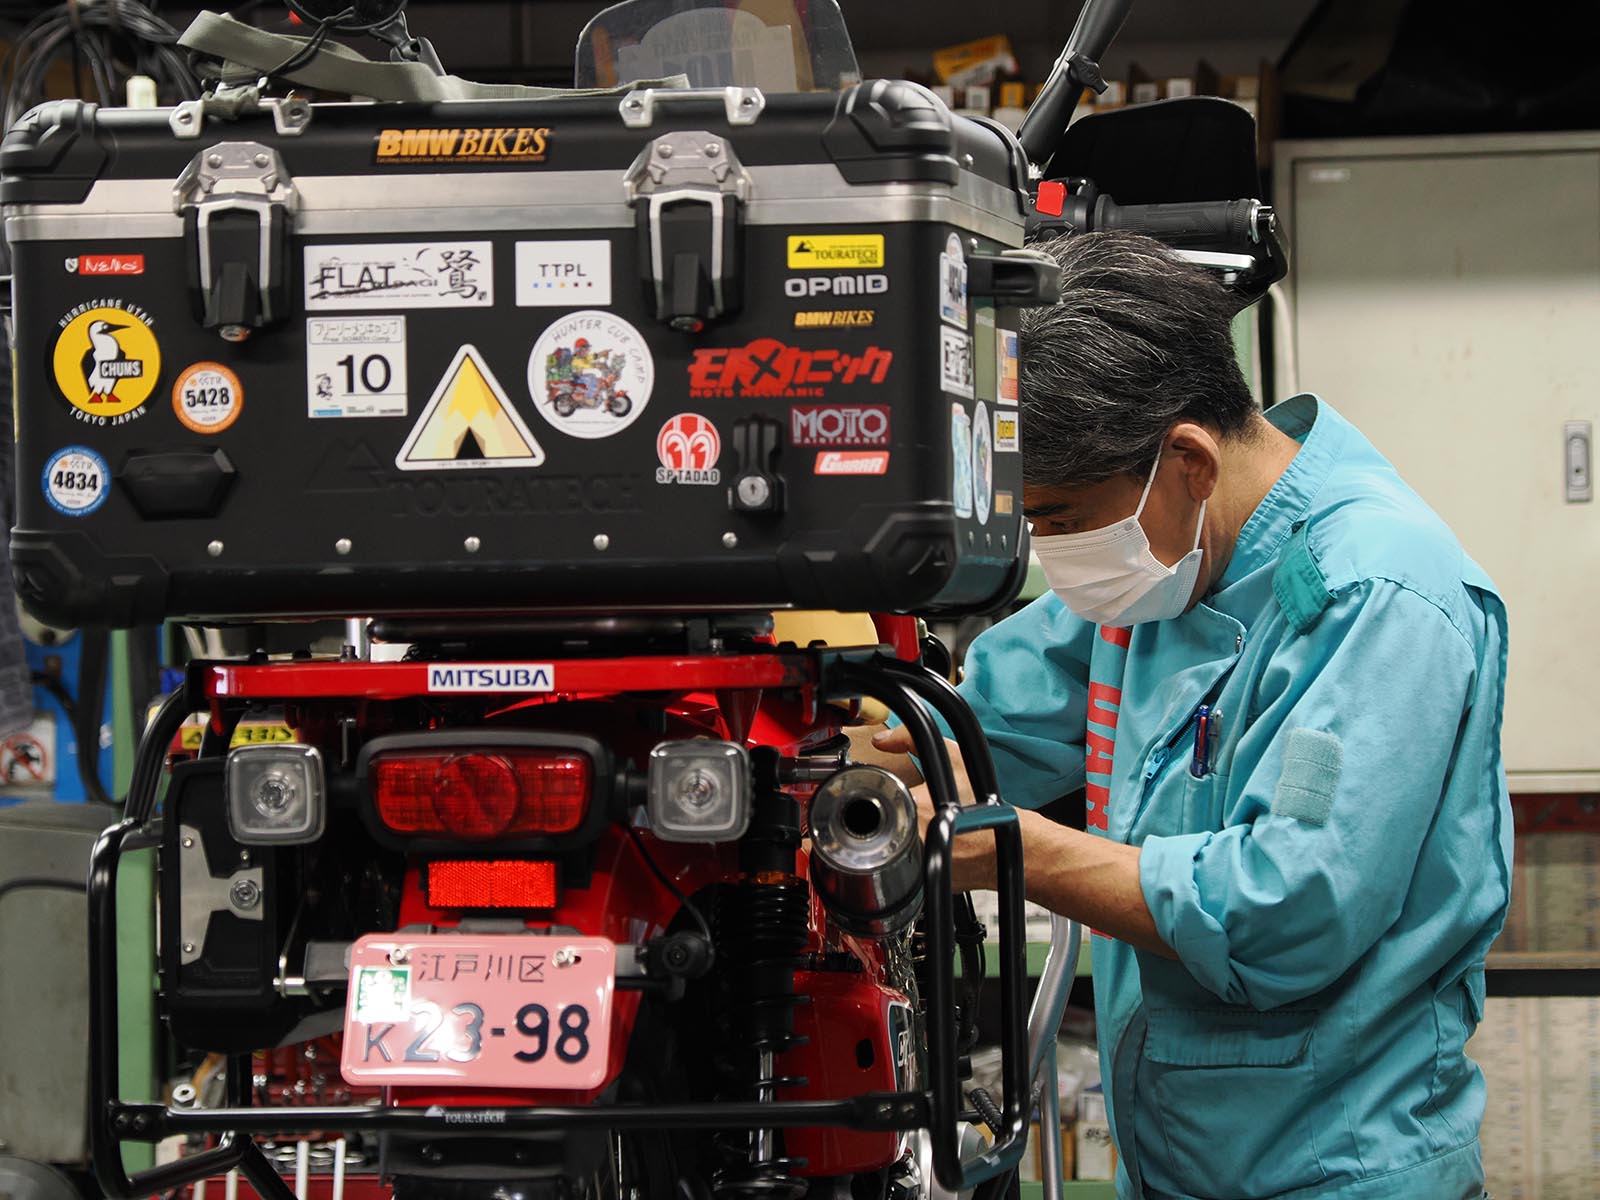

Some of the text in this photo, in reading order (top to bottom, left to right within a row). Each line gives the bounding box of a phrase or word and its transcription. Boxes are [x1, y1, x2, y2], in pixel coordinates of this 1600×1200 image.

[814, 248, 878, 261] TOURATECH
[319, 265, 396, 290] FLAT
[538, 263, 587, 277] TTPL
[784, 274, 888, 297] OPMID
[58, 299, 154, 330] HURRICANE UTAH
[551, 319, 602, 343] HUNTER
[607, 324, 631, 344] CUB
[101, 361, 141, 377] CHUMS
[337, 354, 391, 393] 10
[185, 387, 230, 408] 5428
[689, 387, 734, 398] MOTO
[69, 405, 146, 427] TOKYO JAPAN
[792, 408, 888, 438] MOTO
[52, 470, 98, 492] 4834
[657, 469, 719, 483] SP TADAO
[432, 668, 550, 688] MITSUBA
[417, 953, 547, 983] 江戸川区
[363, 1000, 590, 1064] K 23-98
